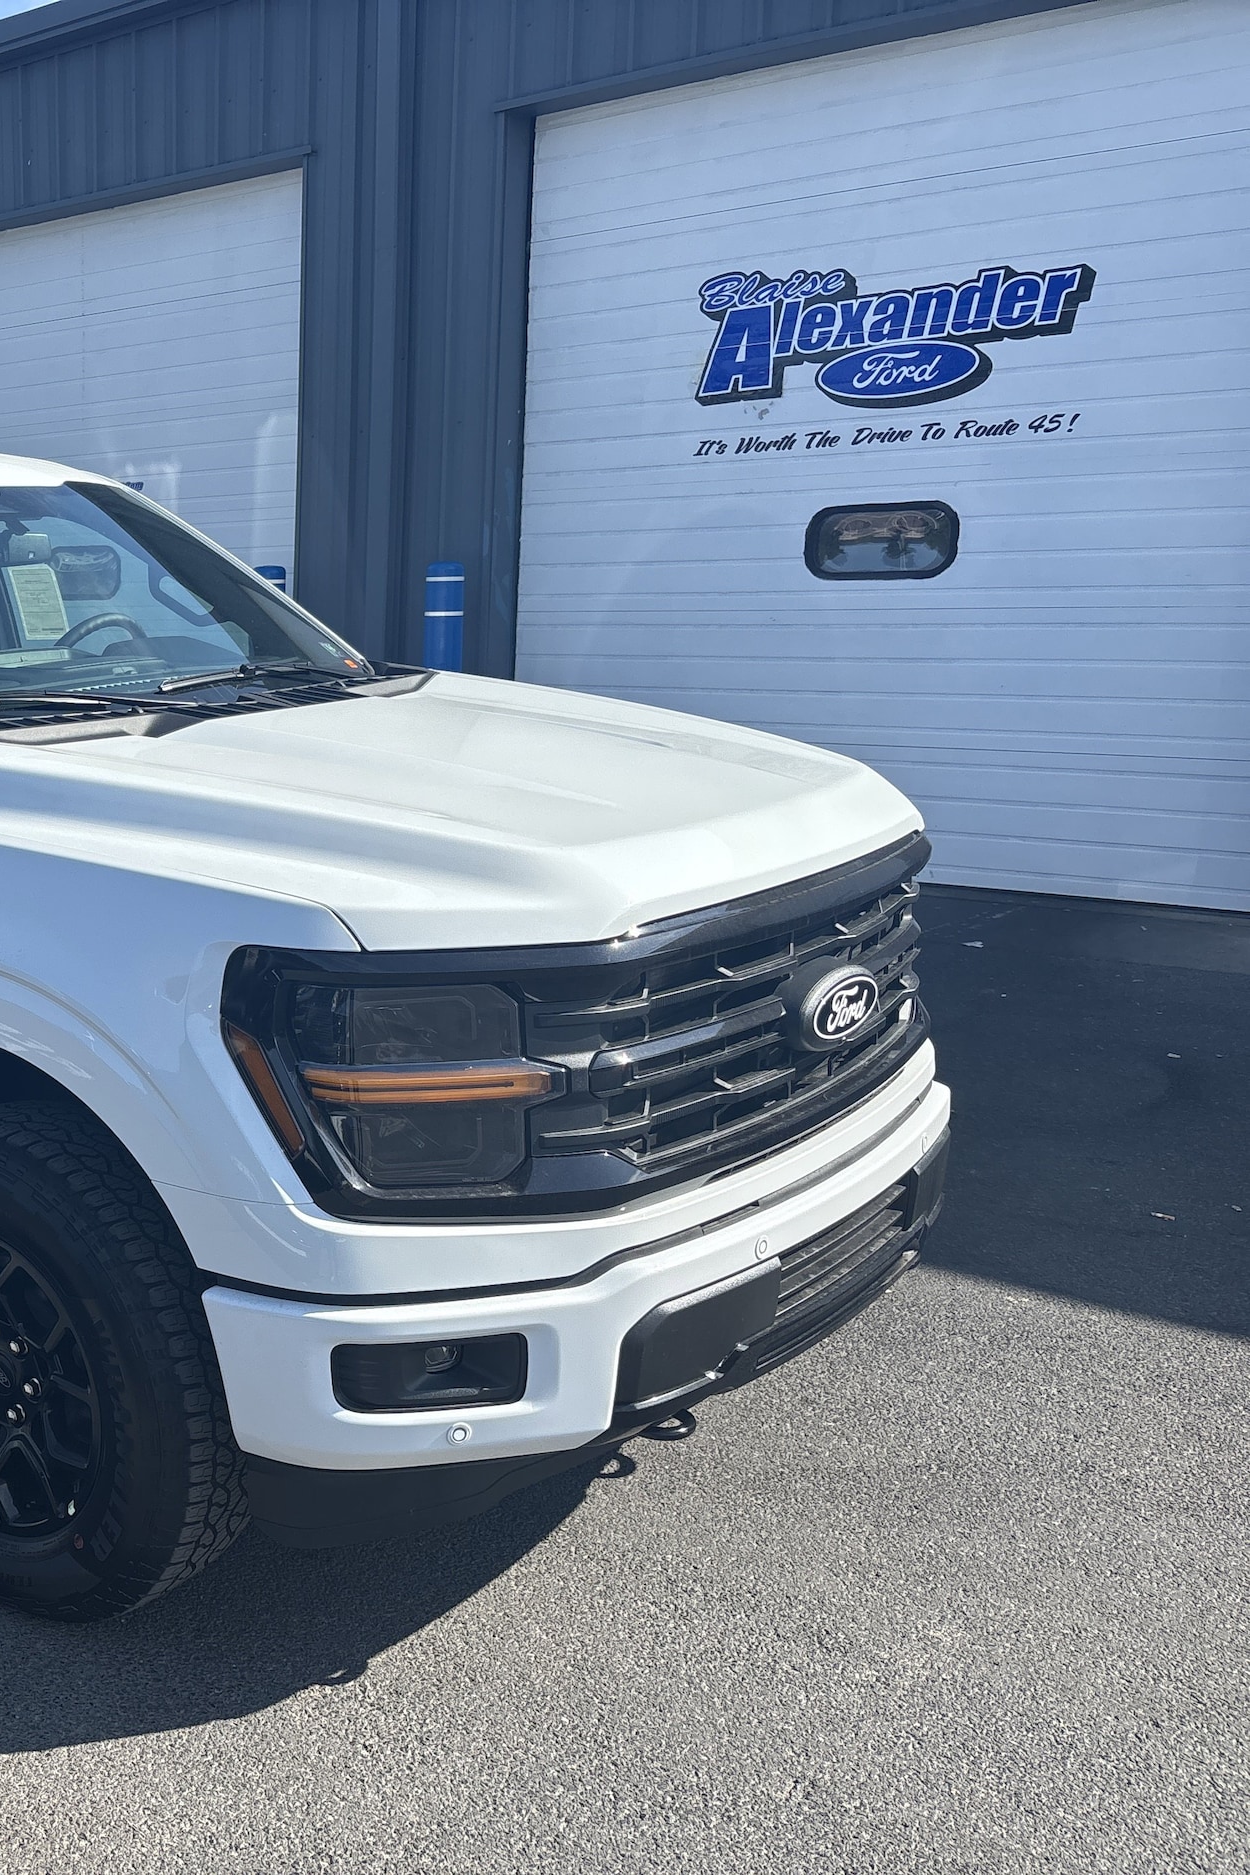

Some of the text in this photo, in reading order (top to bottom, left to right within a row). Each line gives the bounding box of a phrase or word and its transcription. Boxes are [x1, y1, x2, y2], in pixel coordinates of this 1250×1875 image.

[700, 270, 848, 310] Blaise
[696, 264, 1087, 399] Alexander
[852, 351, 940, 389] Ford
[692, 412, 1082, 457] It's Worth The Drive To Route 45!
[827, 985, 868, 1032] Ford
